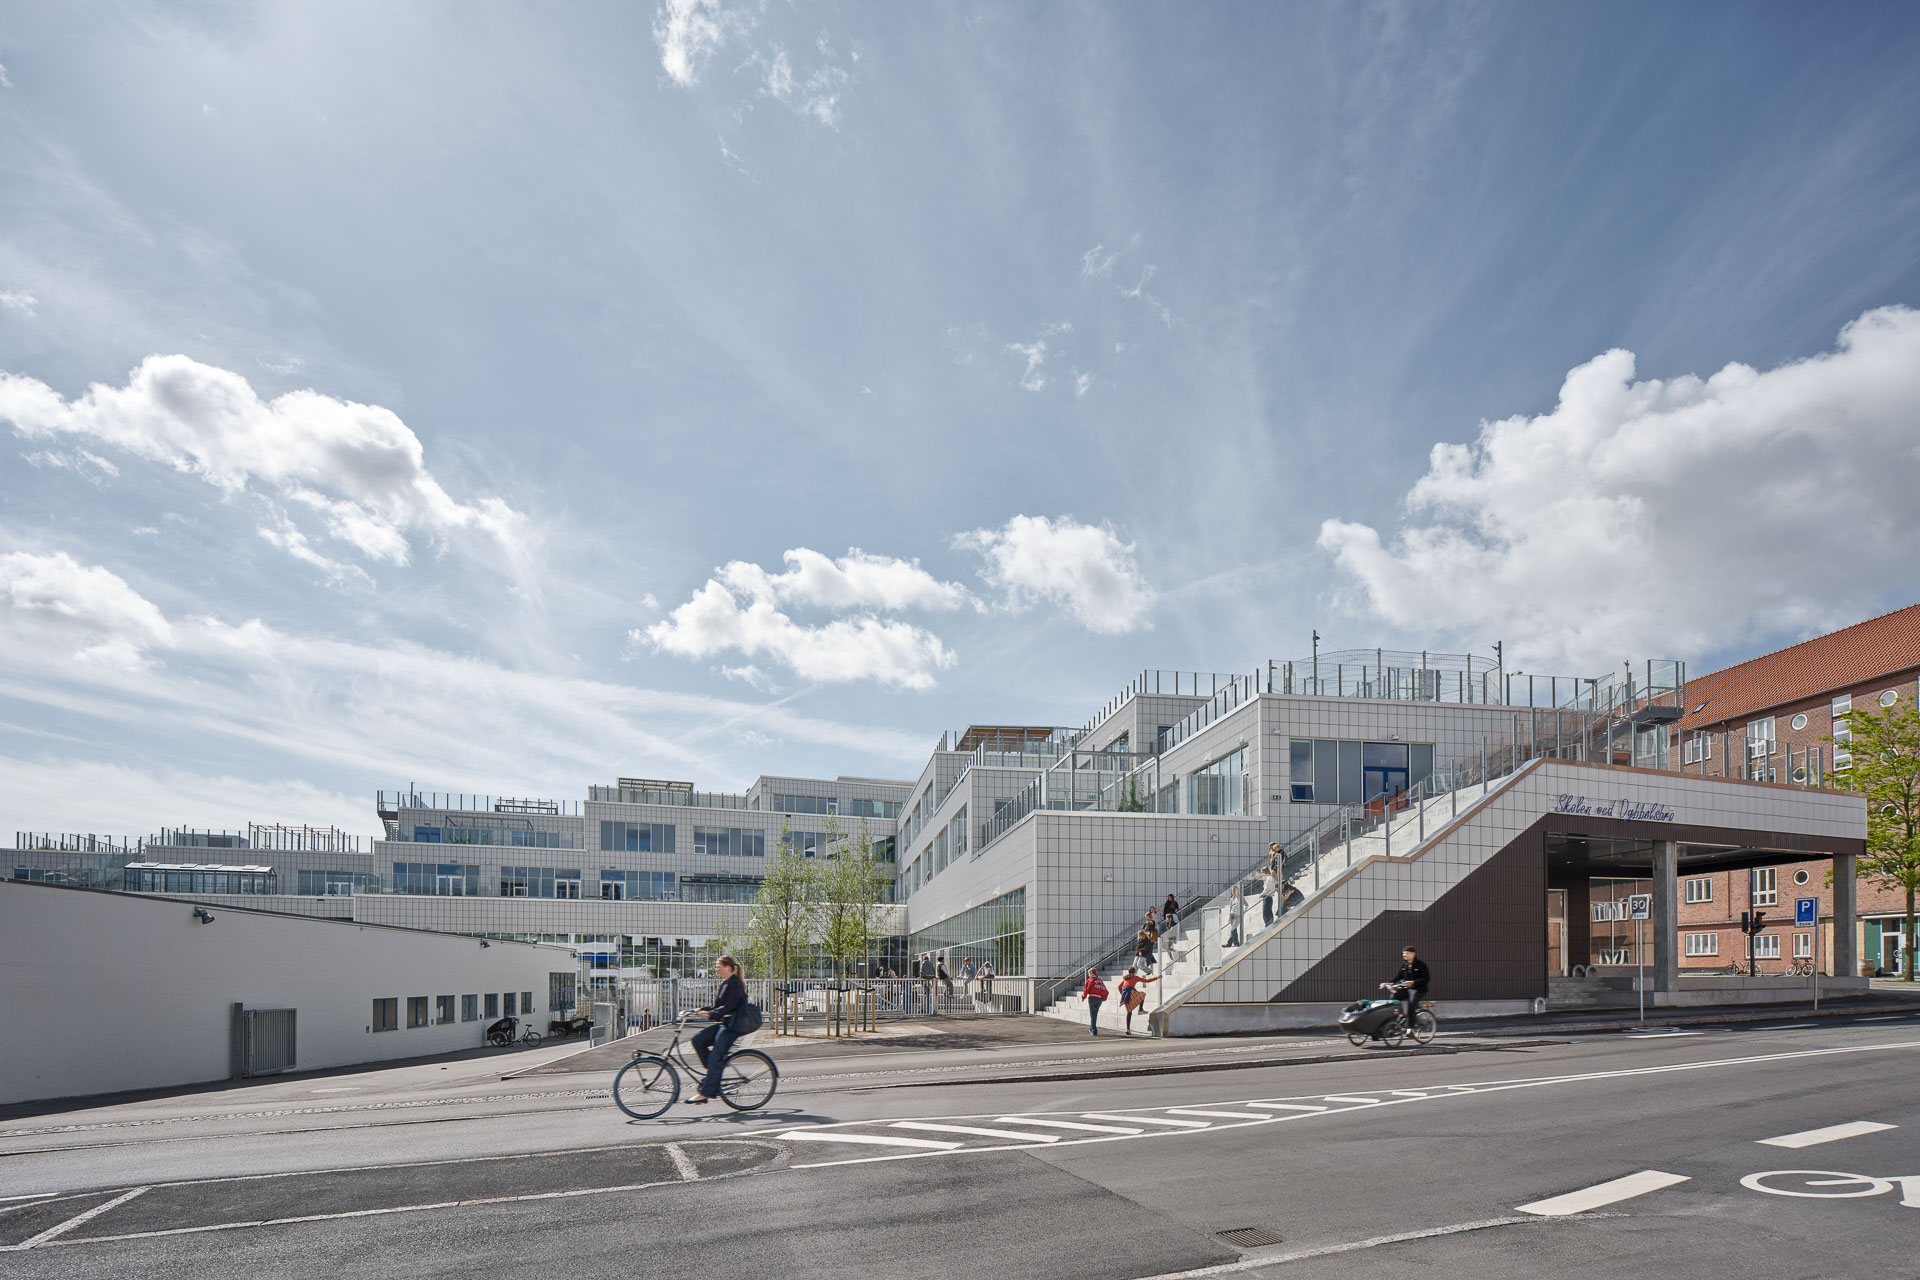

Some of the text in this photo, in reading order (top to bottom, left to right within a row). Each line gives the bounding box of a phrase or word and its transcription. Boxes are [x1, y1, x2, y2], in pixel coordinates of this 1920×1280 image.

[1554, 793, 1592, 816] Skolen
[1597, 800, 1617, 817] ved
[1632, 900, 1646, 910] 30
[1801, 901, 1811, 912] P
